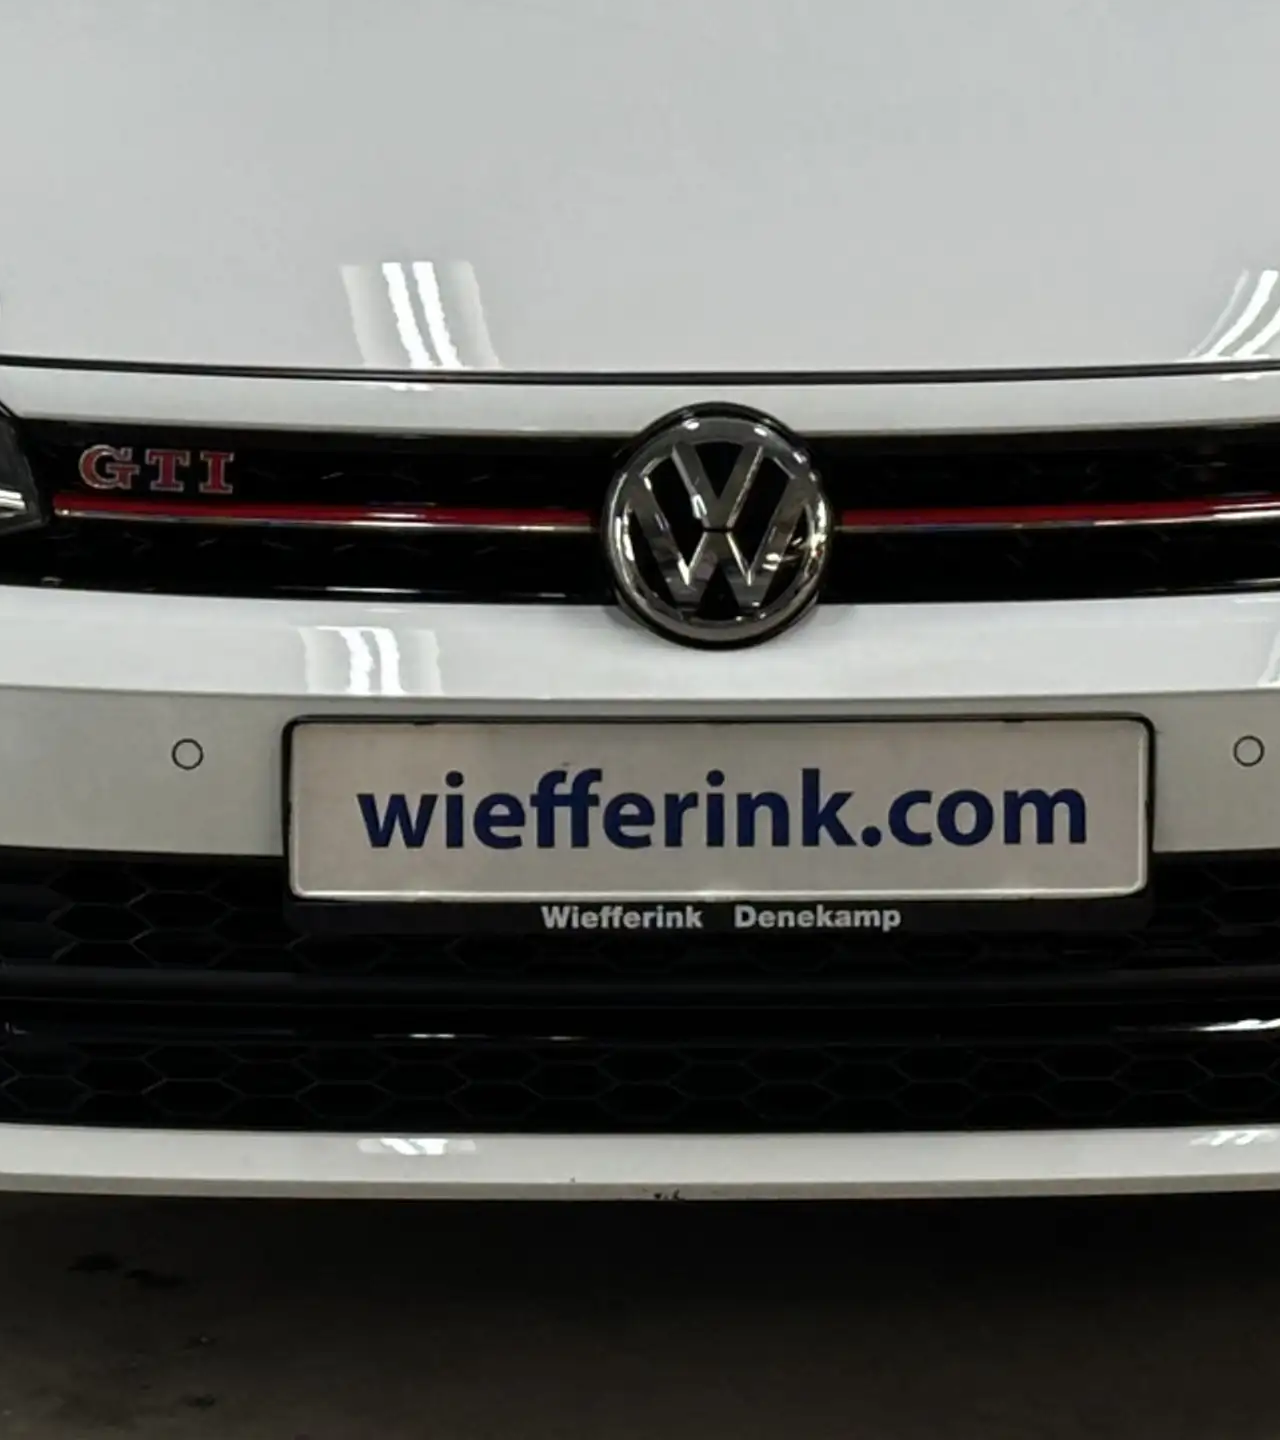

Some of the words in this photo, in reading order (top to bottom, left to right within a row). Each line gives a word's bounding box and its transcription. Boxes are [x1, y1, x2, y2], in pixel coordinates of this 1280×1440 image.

[78, 444, 235, 494] GTI
[356, 767, 1089, 850] wiefferink.com
[540, 905, 703, 929] Wiefferink
[734, 904, 902, 933] Denekamp
